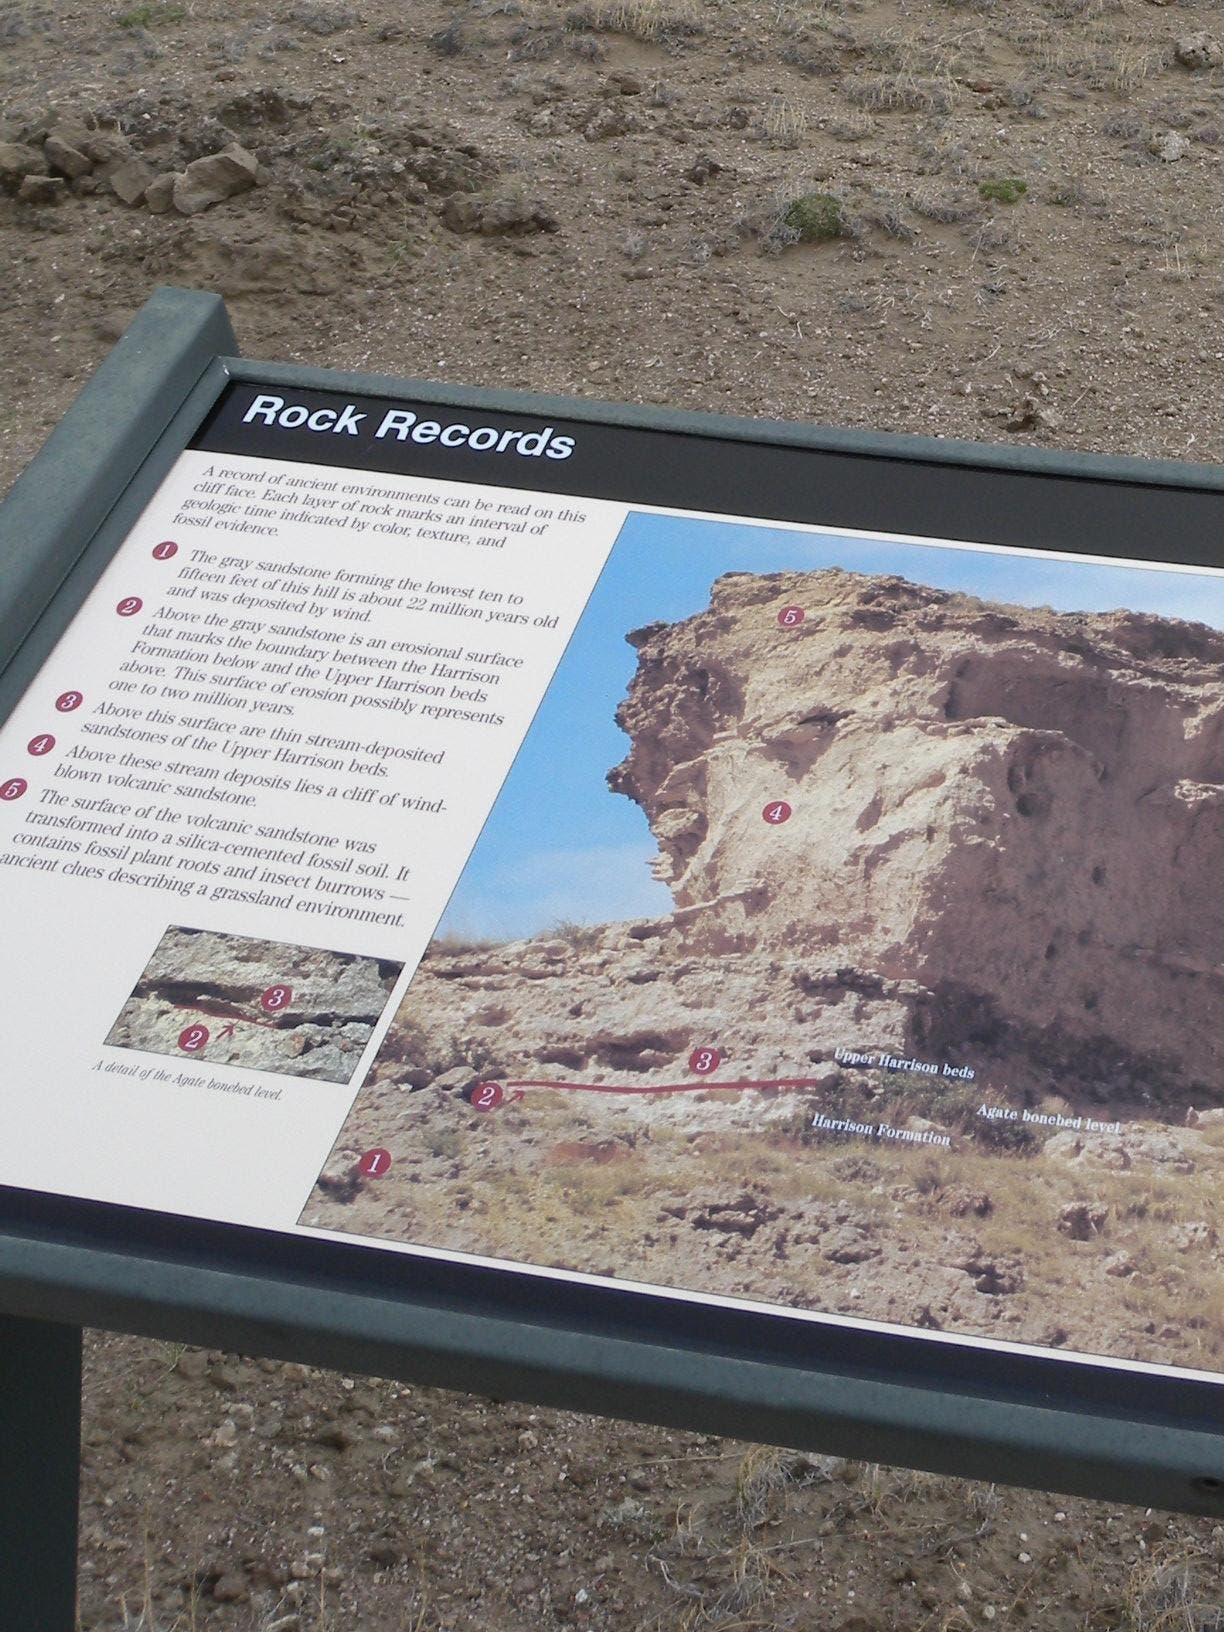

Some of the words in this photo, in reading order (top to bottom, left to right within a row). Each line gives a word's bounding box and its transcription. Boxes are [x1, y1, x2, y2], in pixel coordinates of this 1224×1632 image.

[241, 394, 368, 436] Rock
[374, 409, 576, 460] Records
[180, 498, 242, 515] geologic
[243, 504, 277, 518] time
[279, 508, 350, 528] indicated
[350, 516, 370, 532] by
[372, 521, 412, 538] color,
[416, 527, 470, 545] texture,
[476, 536, 507, 548] and
[192, 480, 226, 494] cliff
[223, 484, 256, 498] face.
[260, 488, 299, 504] Each
[301, 493, 340, 509] layer
[340, 499, 361, 511] of
[358, 503, 394, 516] rock
[395, 508, 443, 523] marks
[445, 515, 465, 525] an
[468, 514, 528, 533] interval
[529, 523, 549, 536] of
[201, 465, 214, 477] A
[217, 469, 267, 483] record
[267, 473, 287, 485] of
[285, 477, 338, 492] ancient
[341, 484, 441, 505] environments
[443, 497, 470, 509] can
[474, 498, 493, 511] be
[495, 503, 532, 516] read
[533, 508, 553, 519] on
[557, 509, 587, 523] this
[165, 585, 199, 599] and
[200, 590, 230, 603] was
[231, 592, 307, 613] deposited
[307, 601, 329, 618] by
[332, 607, 372, 622] wind.
[177, 566, 226, 584] fifteen
[228, 573, 259, 588] feet
[261, 578, 282, 591] of
[279, 580, 310, 596] this
[311, 583, 340, 599] hill
[341, 588, 356, 601] is
[357, 590, 403, 608] about
[405, 597, 428, 611] 22
[428, 601, 483, 619] million
[484, 610, 530, 625] years
[532, 614, 560, 629] old
[189, 549, 217, 564] The
[217, 556, 254, 571] gray
[254, 561, 331, 579] sandstone
[333, 568, 395, 591] forming
[397, 577, 422, 592] the
[425, 580, 475, 599] lowest
[478, 589, 503, 603] ten
[506, 593, 524, 605] to
[141, 623, 174, 639] that
[175, 630, 225, 646] marks
[226, 634, 252, 649] the
[255, 638, 330, 663] boundary
[331, 648, 398, 670] between
[401, 658, 427, 674] the
[429, 662, 500, 685] Harrison
[151, 605, 201, 623] Above
[203, 612, 229, 627] the
[228, 618, 267, 634] gray
[267, 624, 346, 643] sandstone
[348, 632, 364, 646] is
[365, 638, 387, 649] an
[390, 641, 464, 660] erosional
[464, 651, 524, 668] surface
[118, 659, 166, 677] above.
[174, 665, 207, 683] This
[208, 674, 267, 691] surface
[270, 681, 292, 694] of
[289, 686, 348, 703] erosion
[349, 694, 418, 715] possibly
[419, 704, 505, 726] represents
[129, 640, 209, 663] Formation
[212, 651, 260, 670] below
[260, 661, 294, 675] and
[294, 663, 320, 679] the
[324, 667, 374, 687] Upper
[375, 674, 445, 697] Harrison
[448, 684, 488, 703] beds
[80, 722, 169, 745] sandstones
[170, 734, 193, 747] of
[190, 736, 218, 751] the
[221, 739, 272, 760] Upper
[272, 747, 344, 771] Harrison
[347, 758, 388, 777] beds.
[91, 701, 143, 720] Above
[145, 708, 177, 725] this
[177, 716, 237, 734] surface
[239, 725, 266, 738] are
[269, 726, 302, 743] thin
[304, 734, 445, 764] stream-deposited
[53, 762, 103, 783] blown
[106, 773, 172, 793] volcanic
[173, 785, 256, 807] sandstone.
[64, 744, 116, 764] Above
[118, 752, 162, 771] these
[163, 761, 220, 780] stream
[223, 767, 292, 790] deposits
[293, 777, 324, 795] lies
[325, 786, 338, 797] a
[341, 786, 380, 803] cliff
[378, 792, 401, 806] of
[402, 795, 447, 813] wind-
[24, 809, 126, 837] transformed
[124, 824, 159, 842] into
[160, 833, 173, 845] a
[175, 833, 306, 865] silica-cemented
[305, 852, 354, 873] fossil
[354, 862, 389, 879] soil.
[395, 865, 410, 882] It
[39, 788, 70, 806] The
[70, 797, 132, 816] surface
[134, 805, 157, 819] of
[154, 807, 182, 823] the
[186, 813, 253, 835] volcanic
[254, 825, 339, 848] sandstone
[344, 839, 377, 854] was
[11, 832, 82, 853] contains
[83, 839, 131, 860] fossil
[128, 848, 174, 867] plant
[175, 858, 221, 875] roots
[223, 865, 259, 880] and
[258, 867, 312, 889] insect
[314, 875, 386, 901] burrows
[92, 1059, 103, 1071] A
[105, 1061, 139, 1077] detail
[138, 1068, 154, 1081] of
[153, 1069, 171, 1082] the
[173, 1073, 205, 1088] Agate
[207, 1078, 254, 1096] bonebed
[254, 1086, 283, 1101] level.
[834, 1047, 874, 1068] Upper
[878, 1054, 938, 1074] Harrison
[943, 1063, 976, 1079] beds
[811, 1114, 873, 1135] Harrison
[876, 1124, 951, 1146] Formation
[977, 1103, 1018, 1121] Agate
[1022, 1109, 1082, 1130] bonebed
